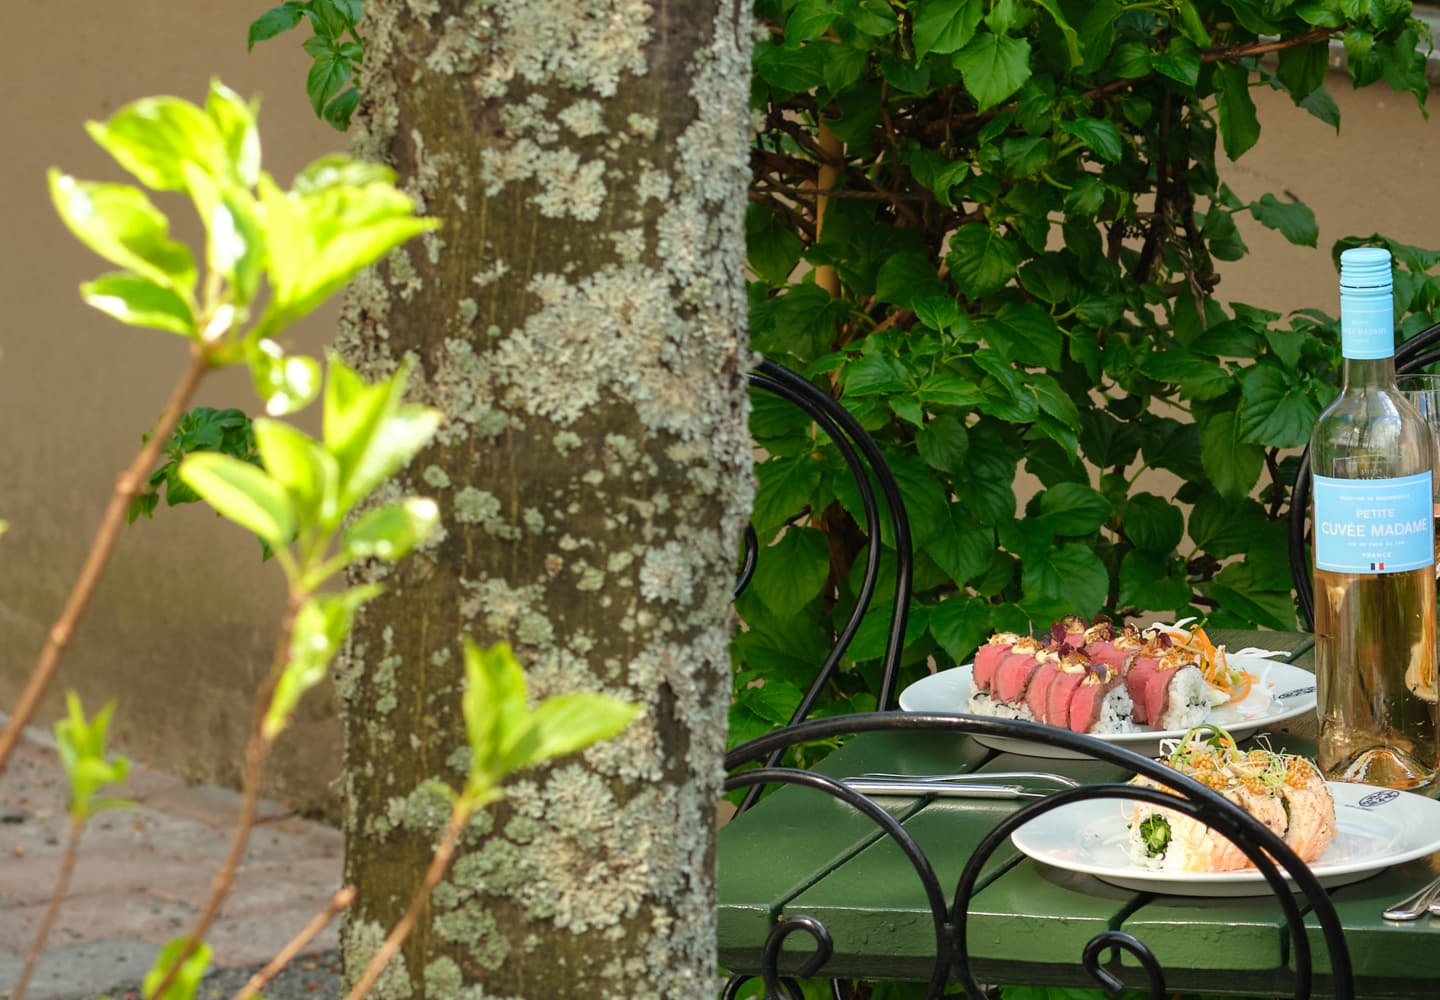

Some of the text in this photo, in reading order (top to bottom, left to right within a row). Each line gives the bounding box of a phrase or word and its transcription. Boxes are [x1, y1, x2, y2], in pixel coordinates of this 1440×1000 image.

[1355, 508, 1395, 519] PETITE
[1321, 518, 1427, 537] CUVÉE MADAME
